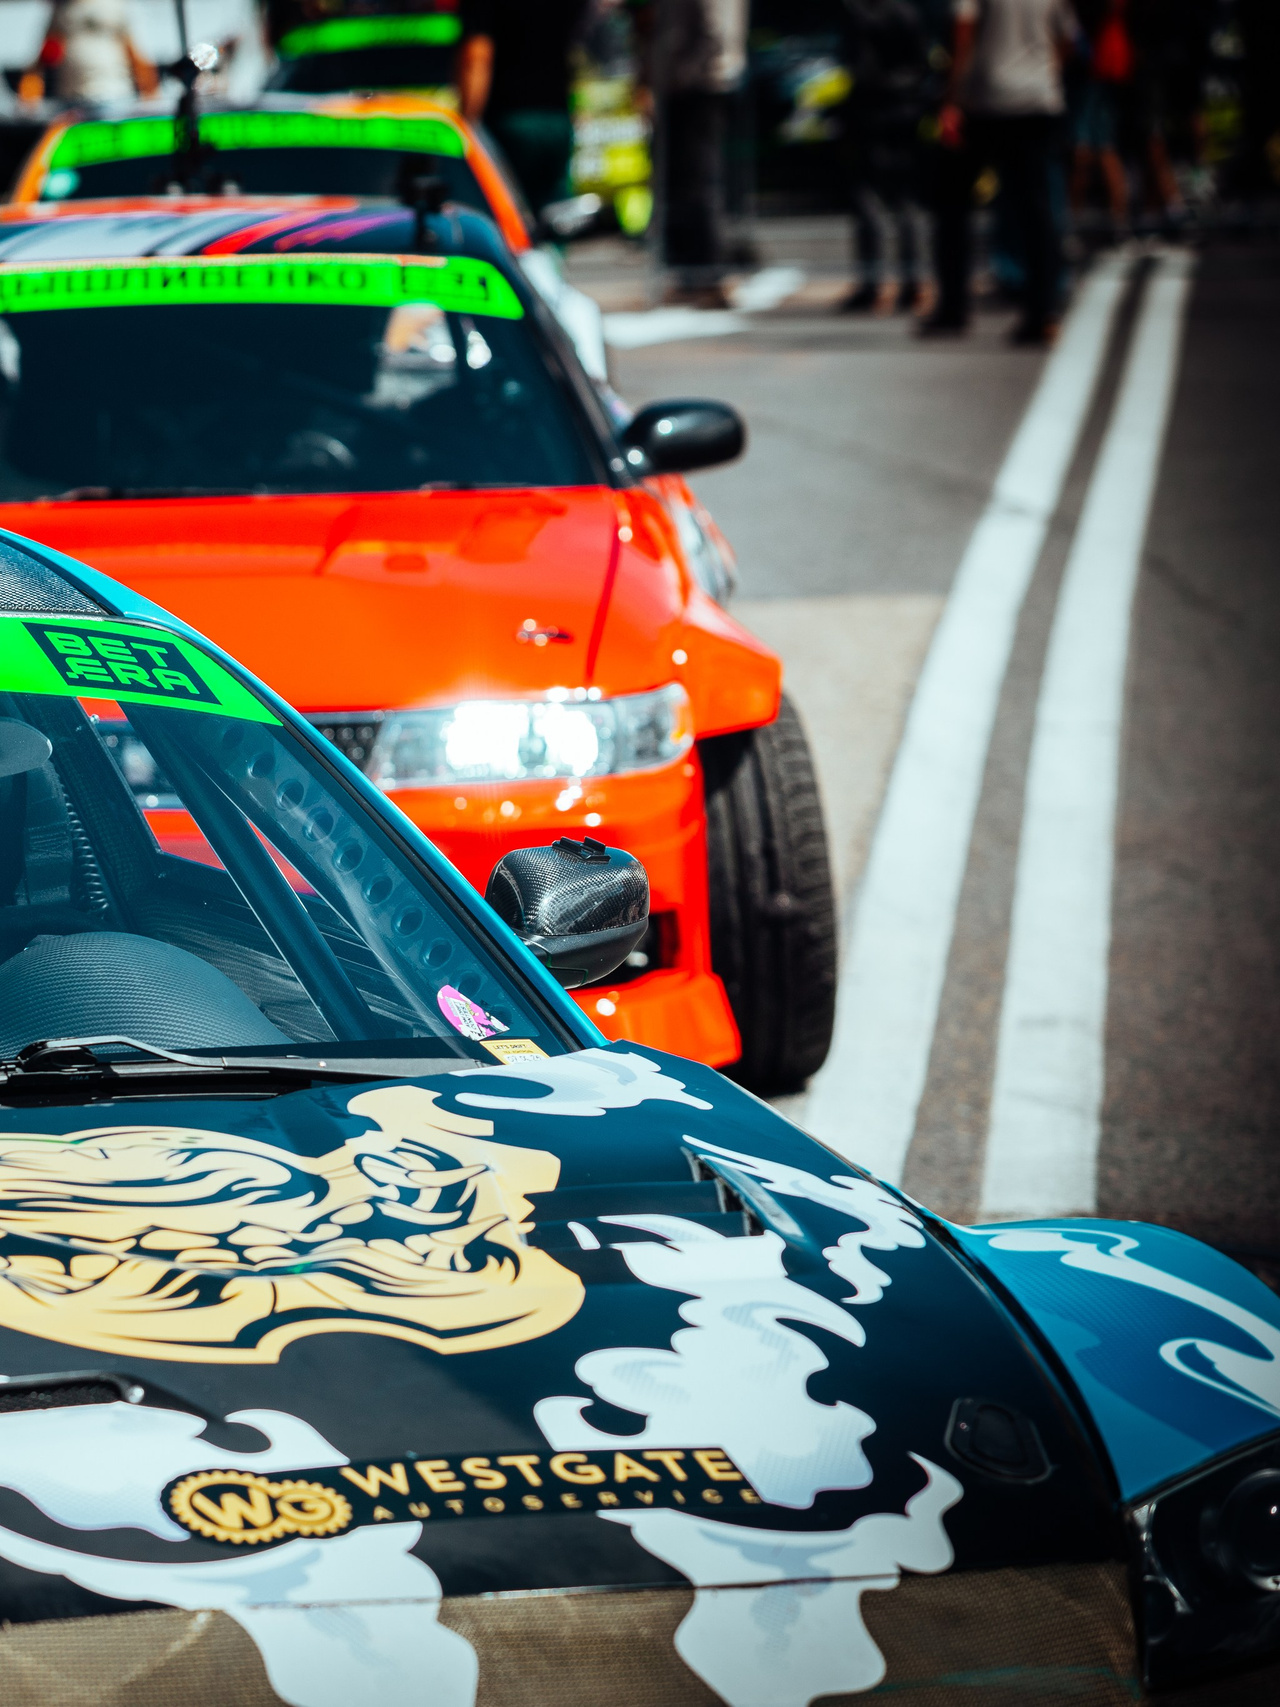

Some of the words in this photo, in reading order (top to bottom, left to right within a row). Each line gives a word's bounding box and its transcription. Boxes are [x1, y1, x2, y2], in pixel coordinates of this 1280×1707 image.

[43, 631, 169, 668] BET
[339, 1450, 744, 1498] WESTGATE
[373, 1488, 762, 1521] AUTOSERVICE
